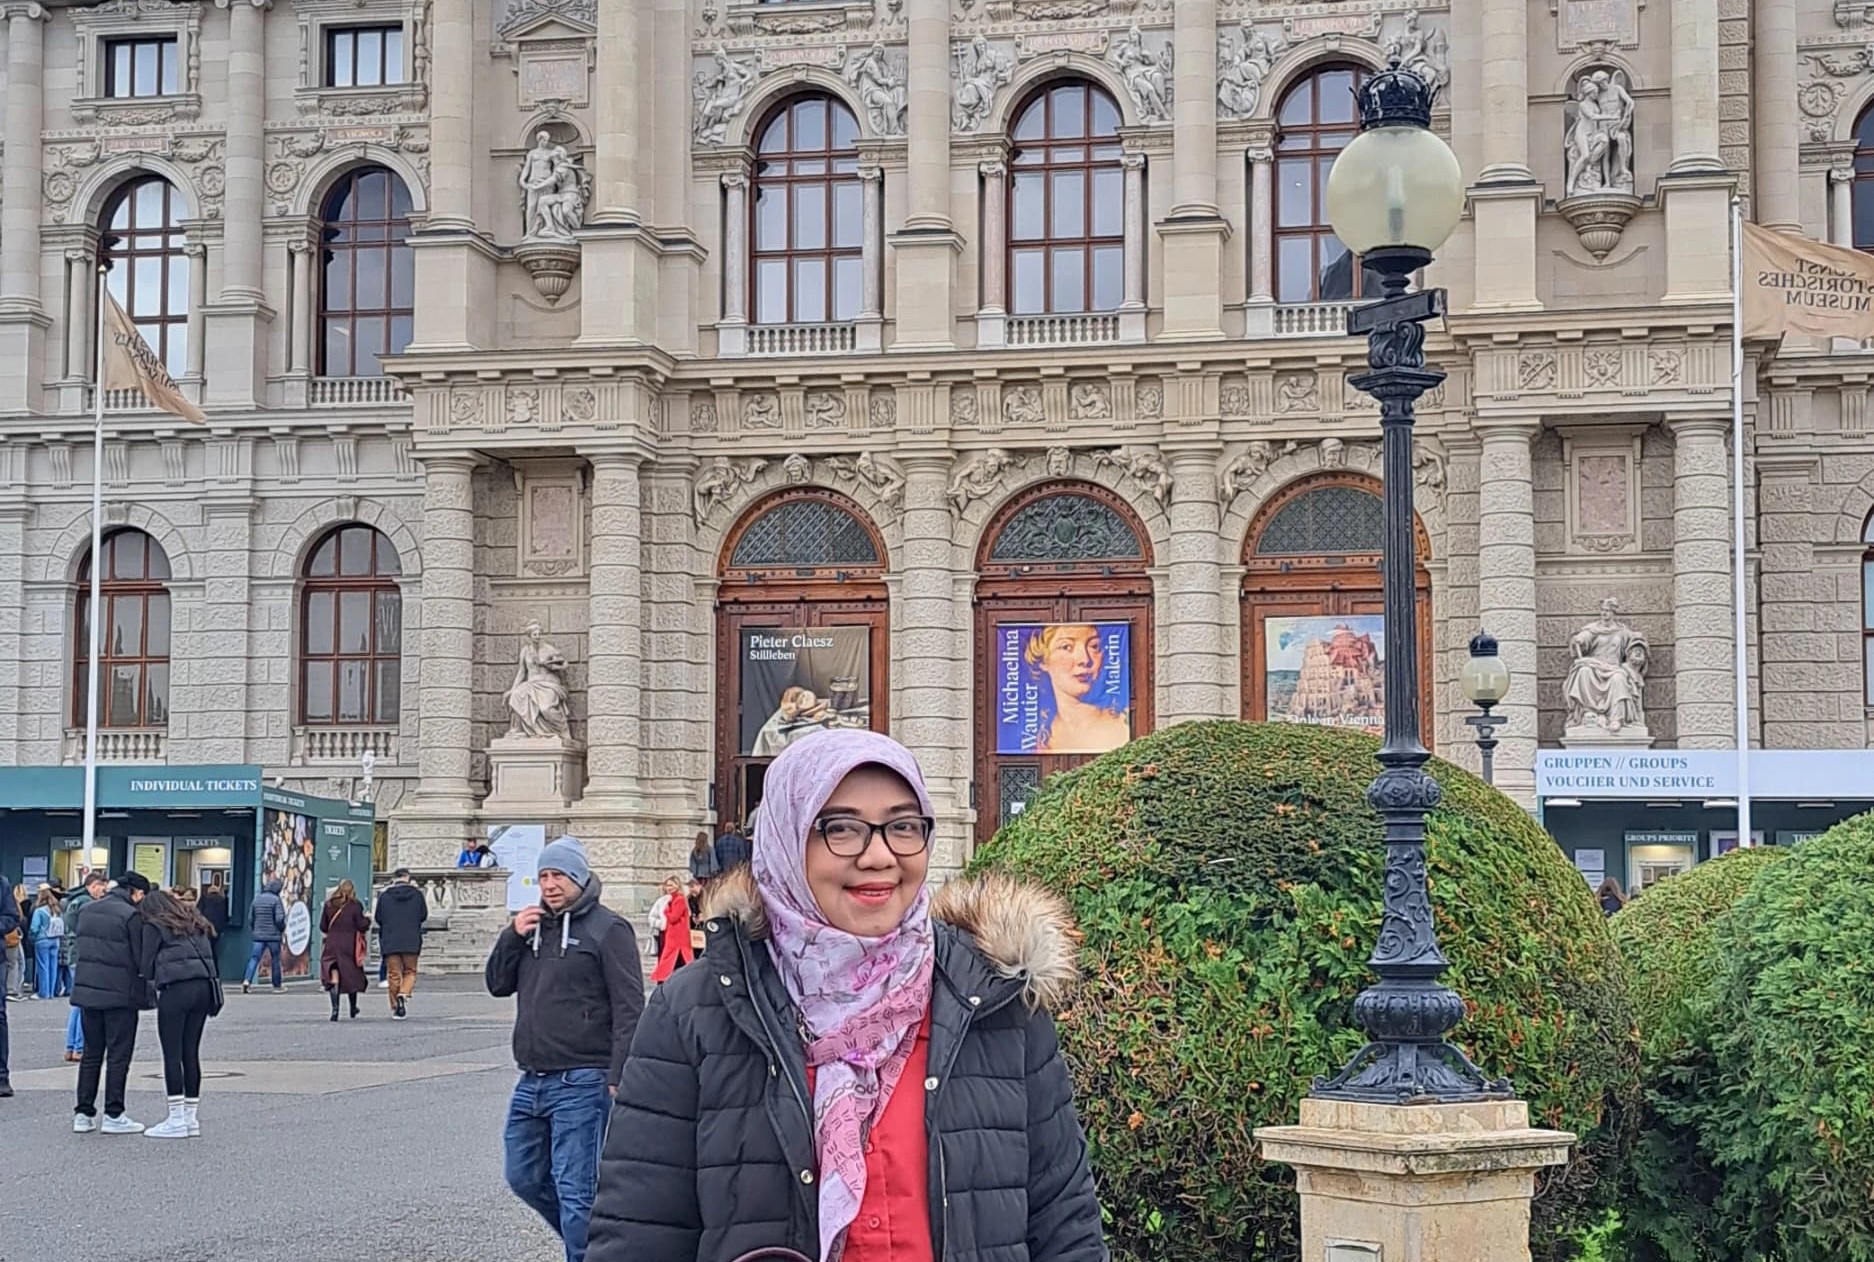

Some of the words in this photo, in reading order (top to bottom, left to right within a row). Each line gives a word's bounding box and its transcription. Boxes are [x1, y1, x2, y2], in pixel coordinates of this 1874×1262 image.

[750, 634, 788, 648] Pieter
[791, 634, 834, 648] Claesz
[1105, 634, 1120, 695] Malerin
[1002, 629, 1019, 724] Michaelina
[1021, 682, 1038, 750] Wautier
[1544, 757, 1612, 769] GRUPPEN
[1628, 757, 1688, 769] GROUPS
[131, 780, 204, 791] INDIVIDUAL
[205, 780, 257, 791] TICKETS
[1546, 776, 1615, 788] VOUCHER
[1619, 776, 1650, 788] UND
[1653, 776, 1715, 788] SERVICE
[186, 838, 219, 847] TICKETS
[1625, 834, 1657, 842] GROUPS
[1659, 834, 1697, 842] PRIORITY
